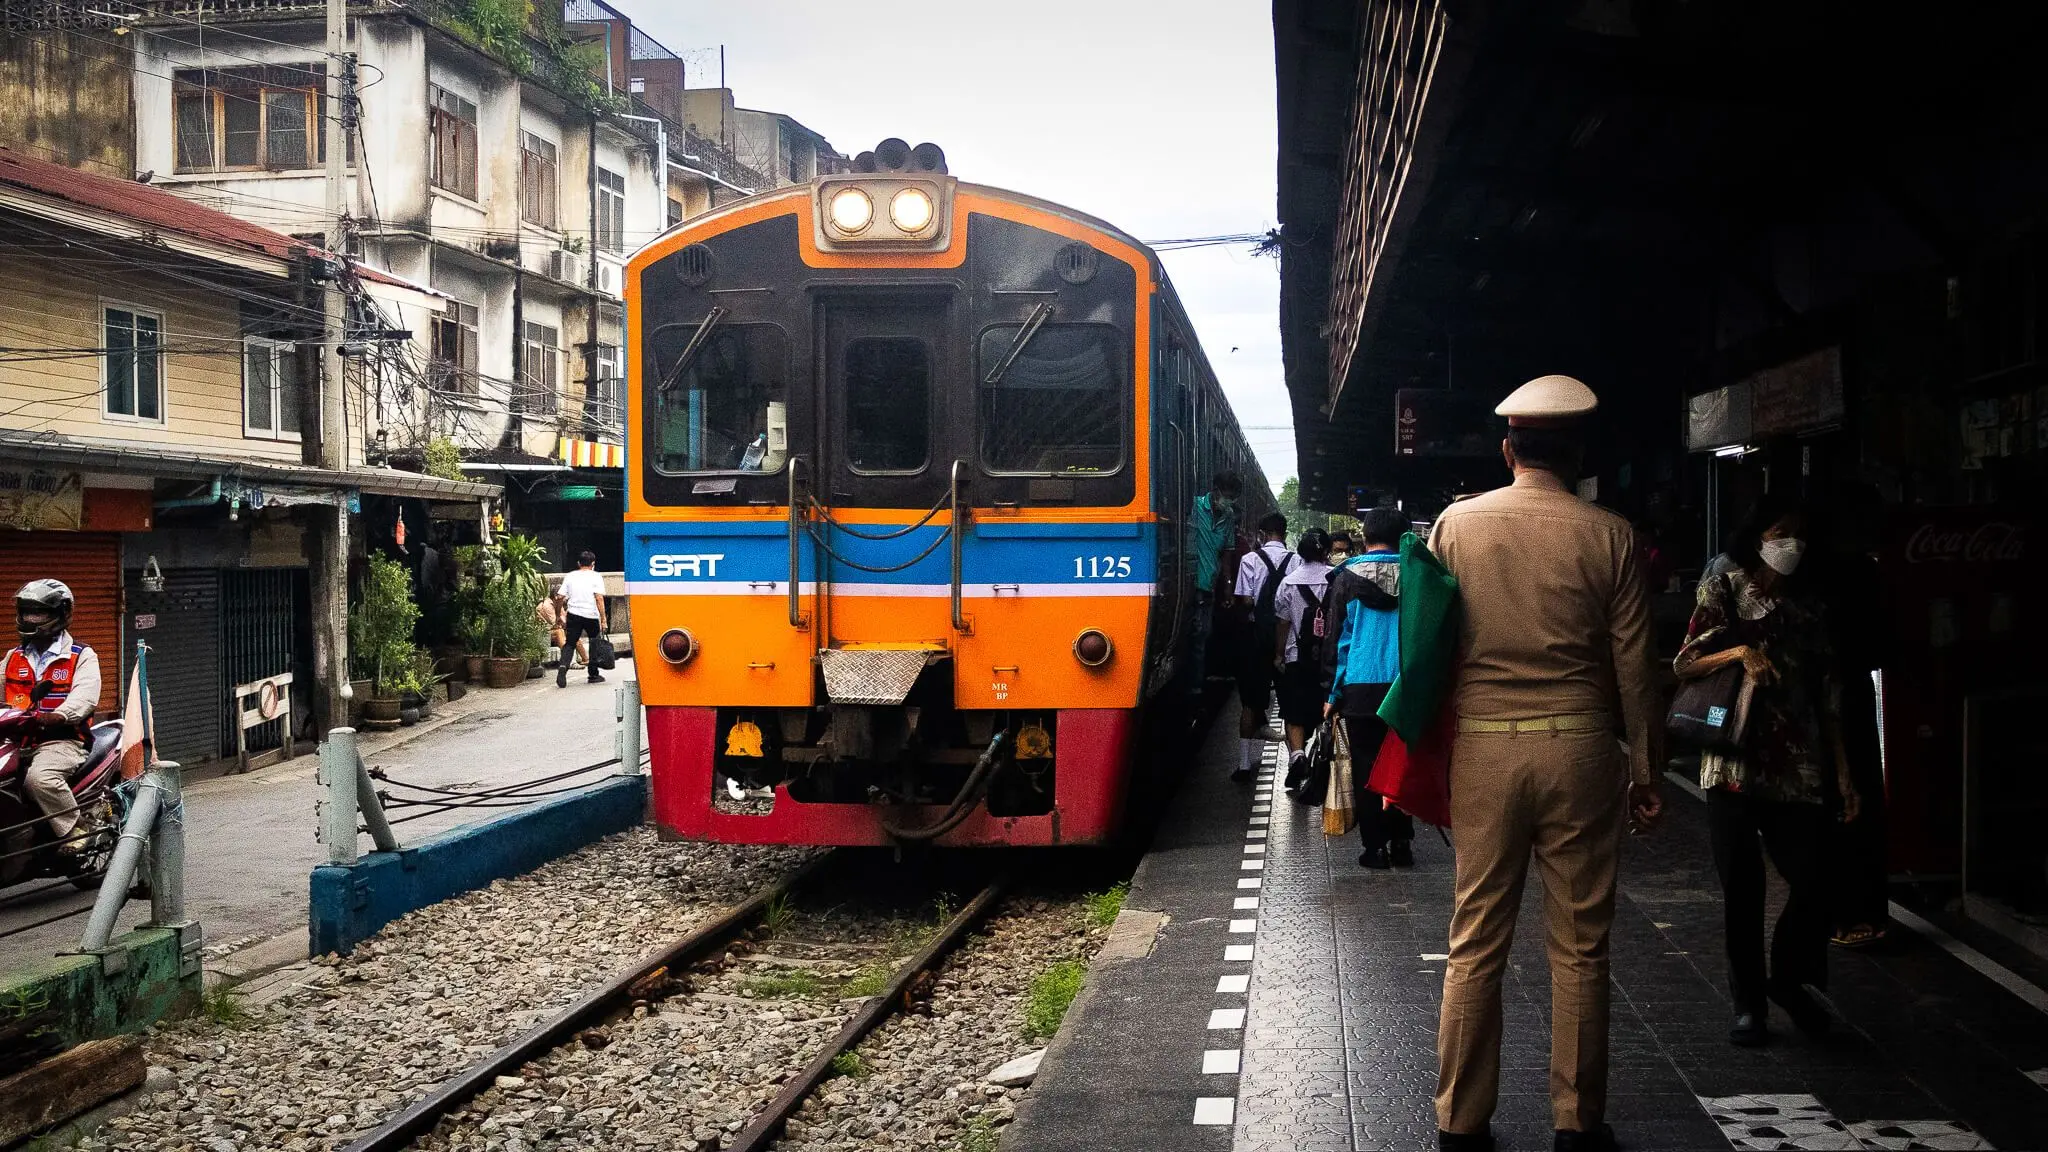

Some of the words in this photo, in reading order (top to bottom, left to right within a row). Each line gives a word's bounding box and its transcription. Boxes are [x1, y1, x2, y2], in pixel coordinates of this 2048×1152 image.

[649, 553, 725, 577] SRT
[1073, 556, 1131, 578] 1125
[991, 683, 1008, 691] MR
[996, 692, 1008, 700] BP
